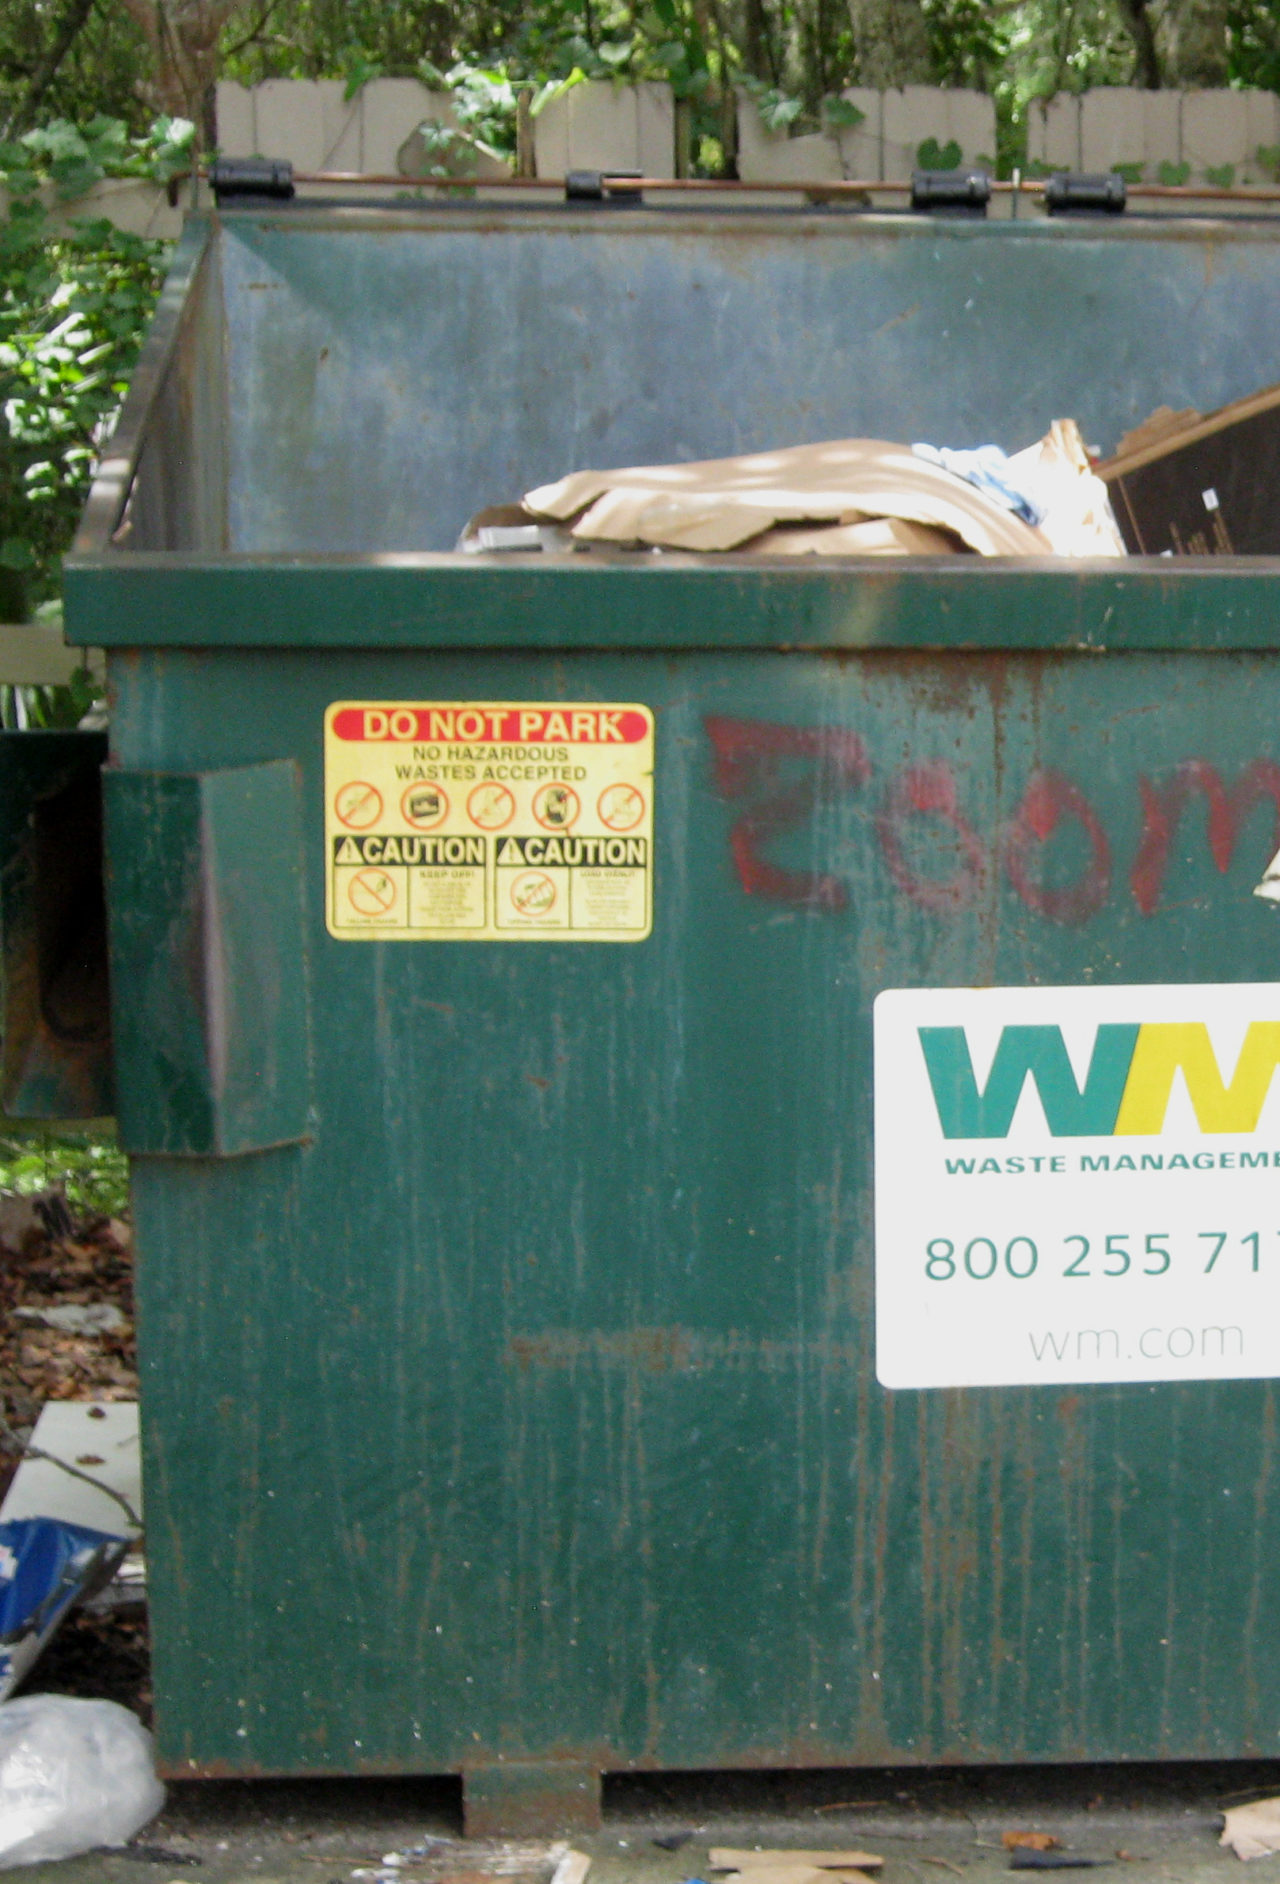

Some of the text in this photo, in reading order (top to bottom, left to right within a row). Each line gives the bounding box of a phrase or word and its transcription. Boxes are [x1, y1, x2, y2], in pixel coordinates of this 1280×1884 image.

[363, 711, 624, 741] DO NOT PARK
[413, 746, 569, 762] NO HAZARDOUS
[395, 765, 587, 781] WASTES ACCEPTED
[362, 838, 485, 864] CAUTION
[524, 838, 646, 864] CAUTION
[945, 1156, 1067, 1175] WASTE
[924, 1236, 1039, 1280] 800
[1062, 1233, 1172, 1277] 255
[1028, 1326, 1244, 1361] wm.com
